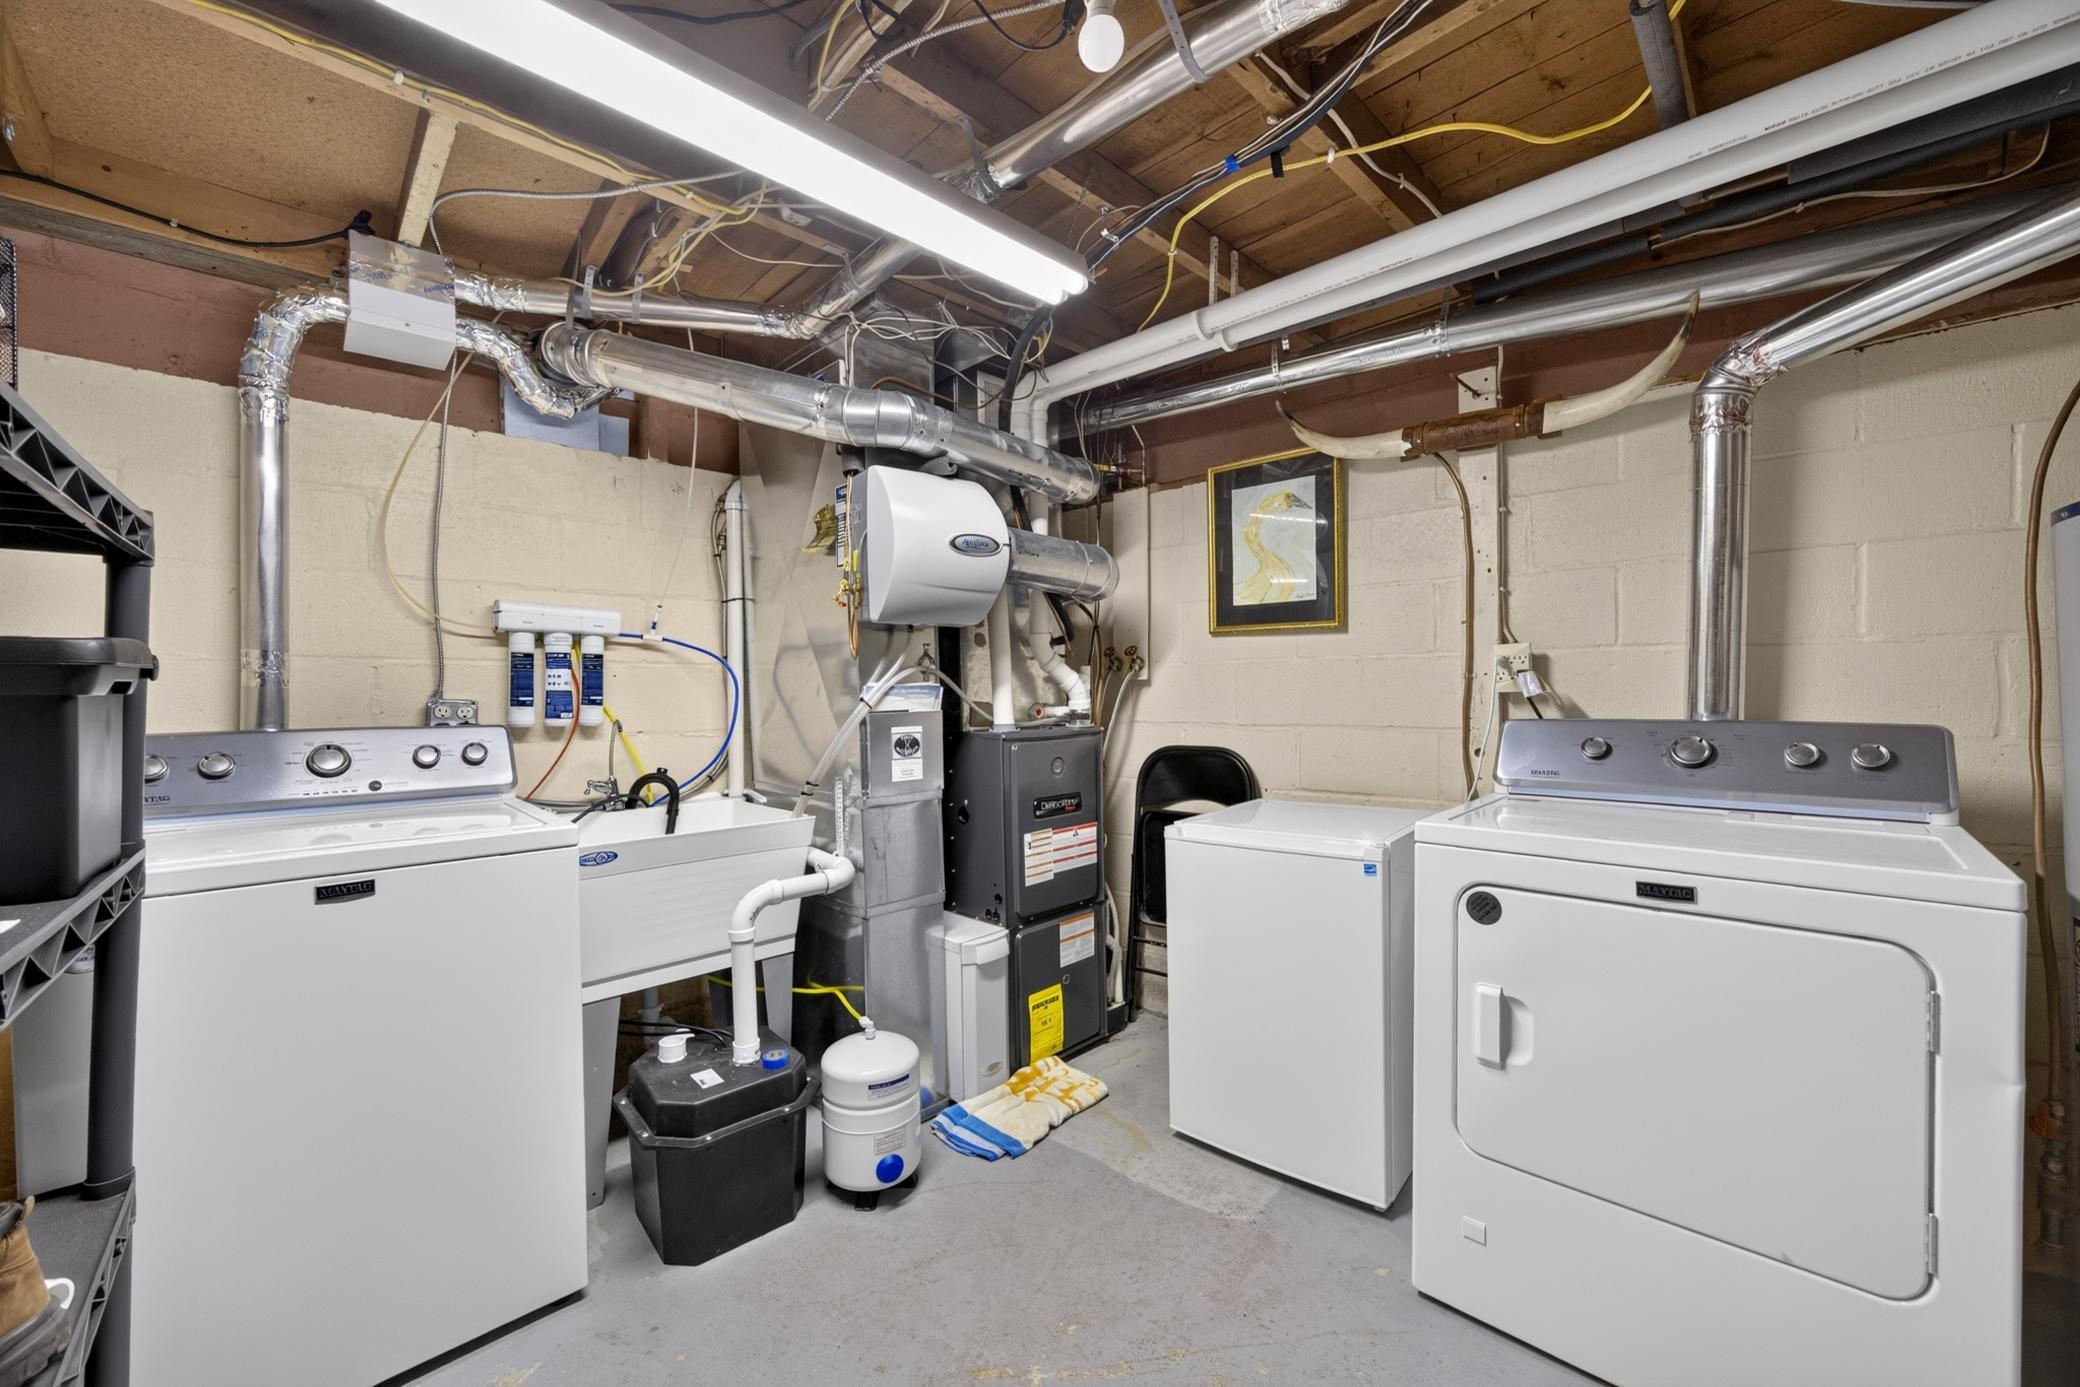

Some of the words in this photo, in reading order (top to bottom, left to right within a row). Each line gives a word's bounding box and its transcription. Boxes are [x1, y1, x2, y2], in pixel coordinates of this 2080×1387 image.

[144, 795, 170, 803] YTAG
[319, 881, 372, 898] MAYTAG
[1638, 883, 1692, 899] MAYTAG
